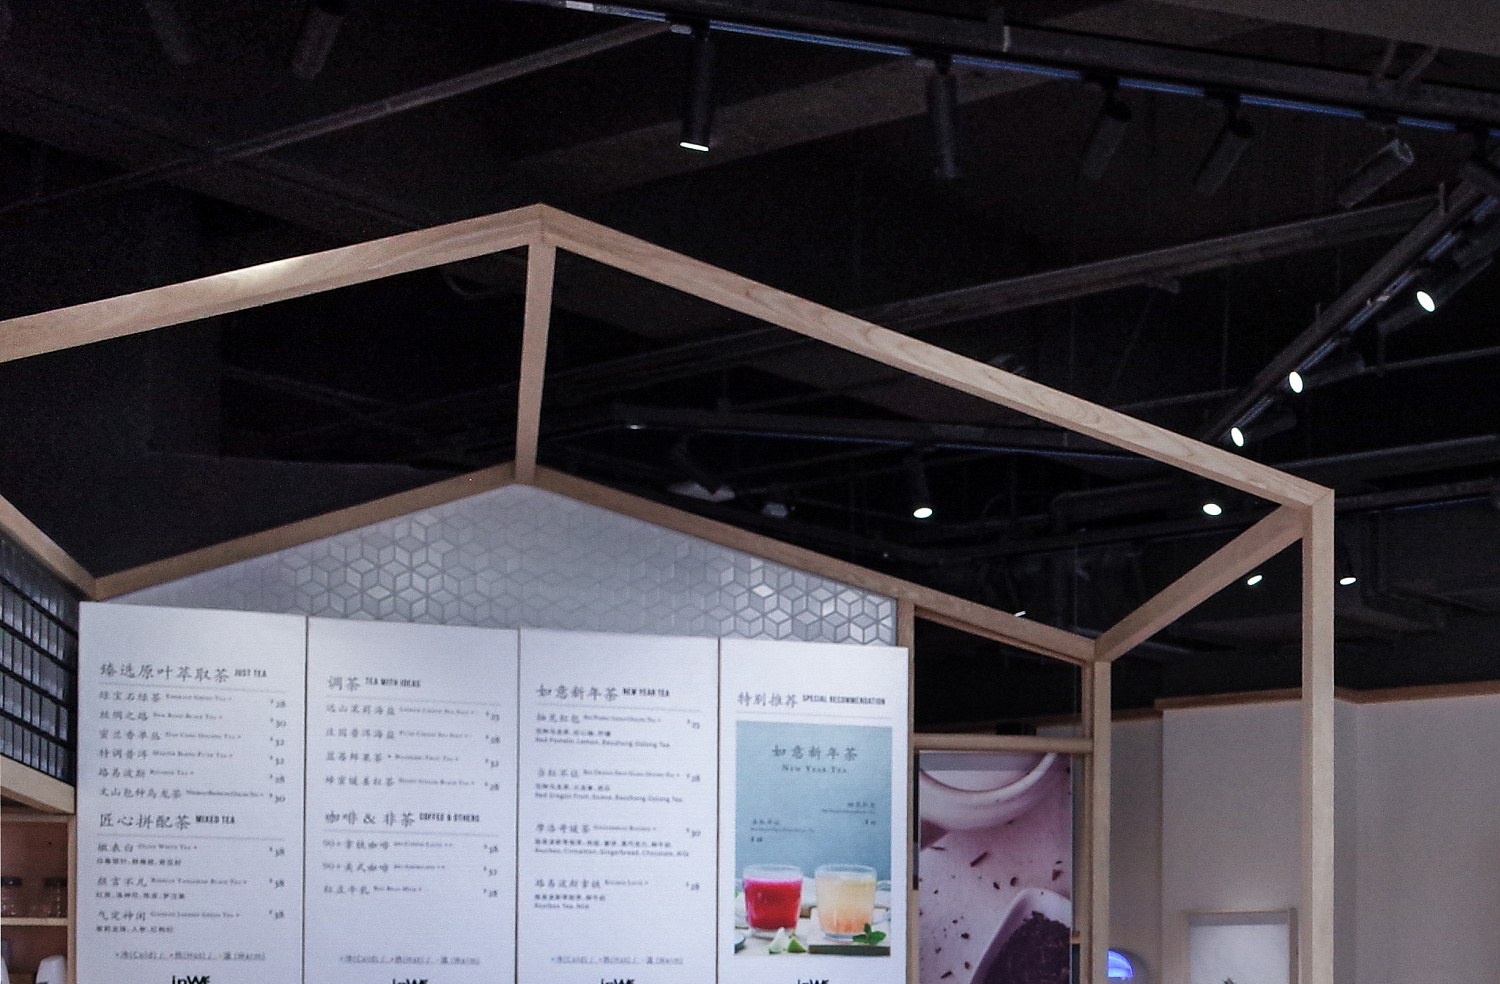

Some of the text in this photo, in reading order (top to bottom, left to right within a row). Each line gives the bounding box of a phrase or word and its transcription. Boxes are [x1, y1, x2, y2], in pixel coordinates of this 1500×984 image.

[253, 669, 267, 677] TEA
[328, 675, 360, 691] 调茶
[536, 684, 670, 701] 如意新年茶 NEW YEAR TEA
[737, 691, 798, 708] 特别推荐
[772, 744, 858, 761] 如意新年茶
[100, 813, 236, 830] 匠心拼配茶 MIXED TEA
[419, 812, 444, 822] COFFEE
